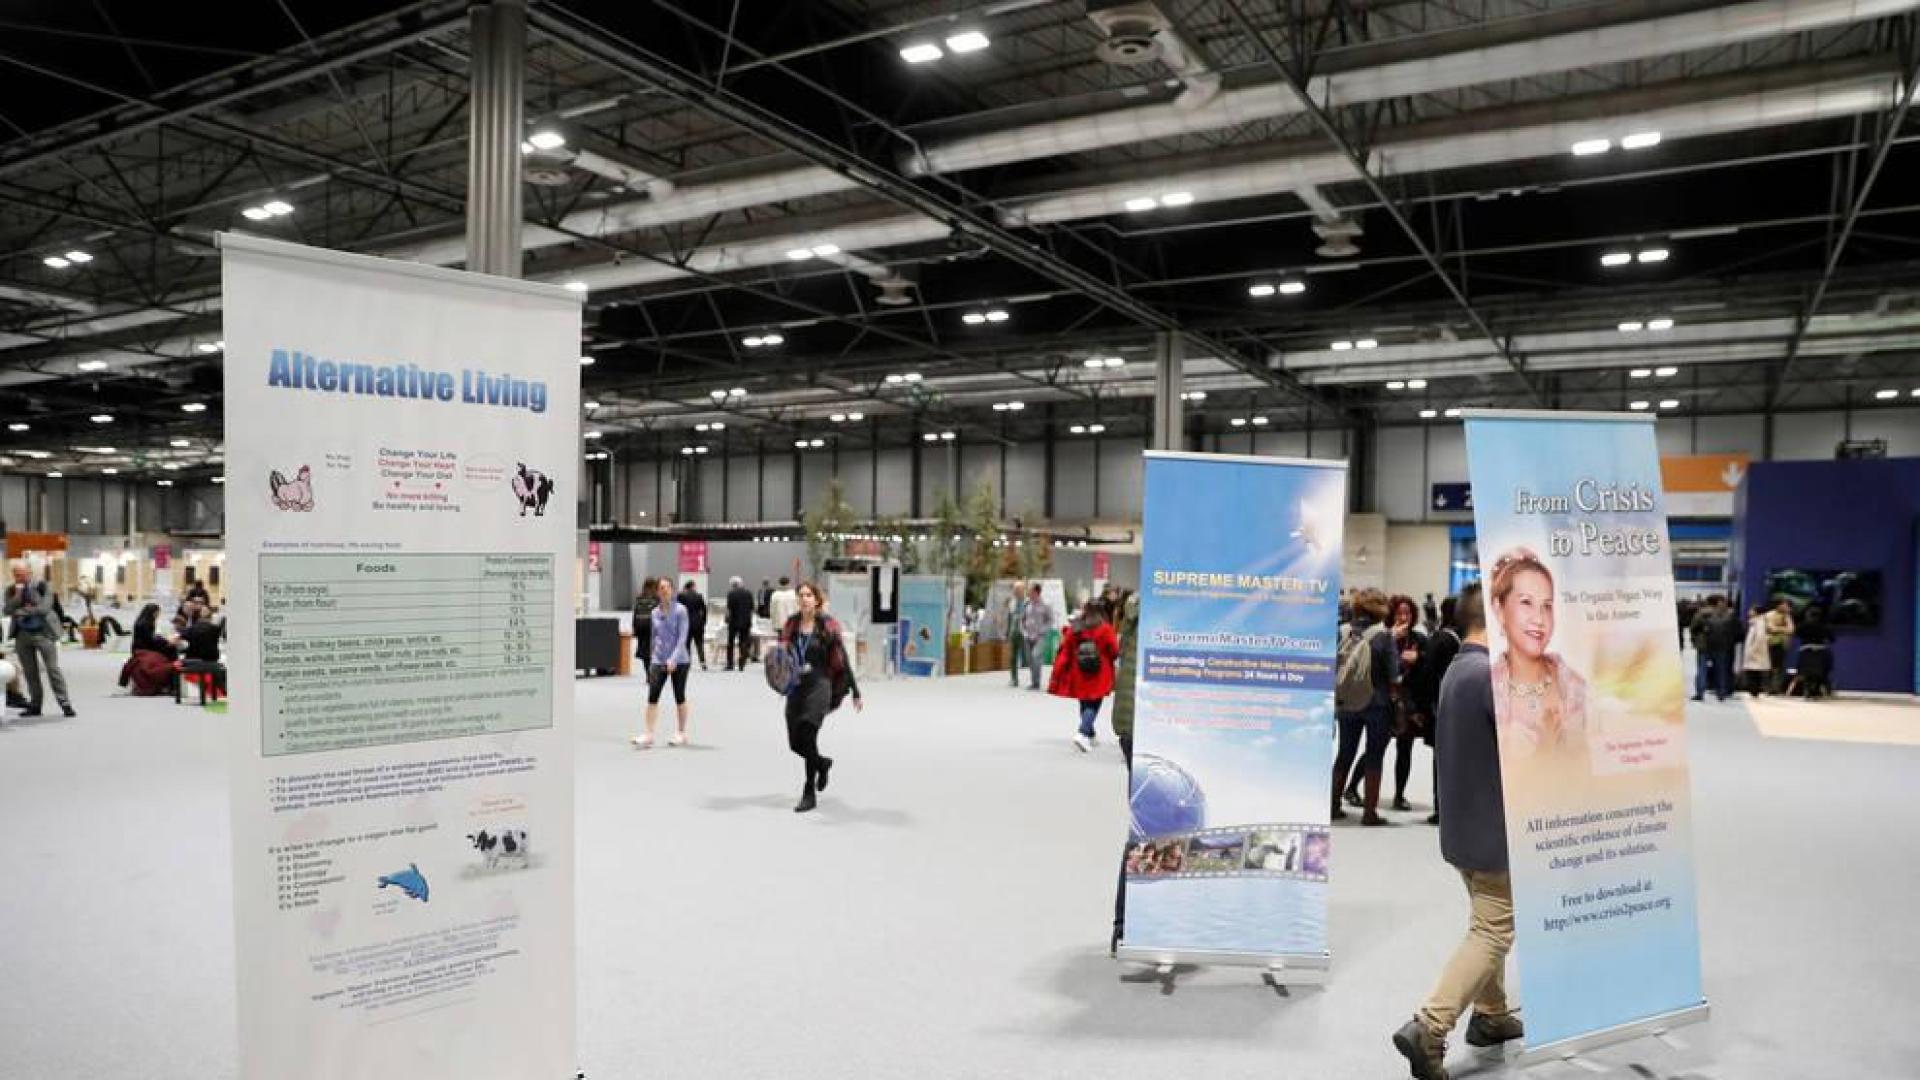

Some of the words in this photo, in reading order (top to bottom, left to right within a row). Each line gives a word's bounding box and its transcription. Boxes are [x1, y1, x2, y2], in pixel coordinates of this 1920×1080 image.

[268, 348, 455, 402] Alternative
[462, 369, 547, 414] Living
[377, 458, 414, 472] Change
[416, 460, 435, 472] Your
[433, 462, 456, 473] Heart
[379, 447, 414, 460] Change
[417, 449, 437, 461] Your
[440, 450, 457, 462] Life
[381, 469, 416, 483] Change
[418, 471, 436, 482] Your
[1515, 487, 1569, 514] From
[1576, 479, 1656, 514] Crisis
[373, 502, 384, 512] Be
[387, 502, 416, 515] healthy
[419, 504, 434, 512] and
[436, 504, 460, 516] loving
[1550, 530, 1573, 558] to
[1580, 521, 1661, 559] Peace
[356, 563, 397, 573] Foods
[698, 555, 704, 571] 1
[1153, 571, 1233, 589] SUPREME
[1237, 576, 1304, 592] MASTER
[1307, 579, 1330, 595] TV
[1153, 630, 1323, 651] SupremeMasterTV.com
[1288, 671, 1305, 685] Day
[1525, 820, 1542, 836] All
[1544, 810, 1602, 832] information
[1604, 804, 1655, 826] concerning
[1657, 800, 1673, 814] the
[1534, 831, 1580, 853] scientific
[1580, 827, 1620, 847] evidence
[1622, 823, 1632, 838] of
[1549, 850, 1583, 871] change
[1586, 848, 1604, 864] and
[1560, 890, 1582, 908] Free
[1584, 890, 1594, 904] to
[1595, 881, 1641, 901] download
[1642, 880, 1654, 893] at
